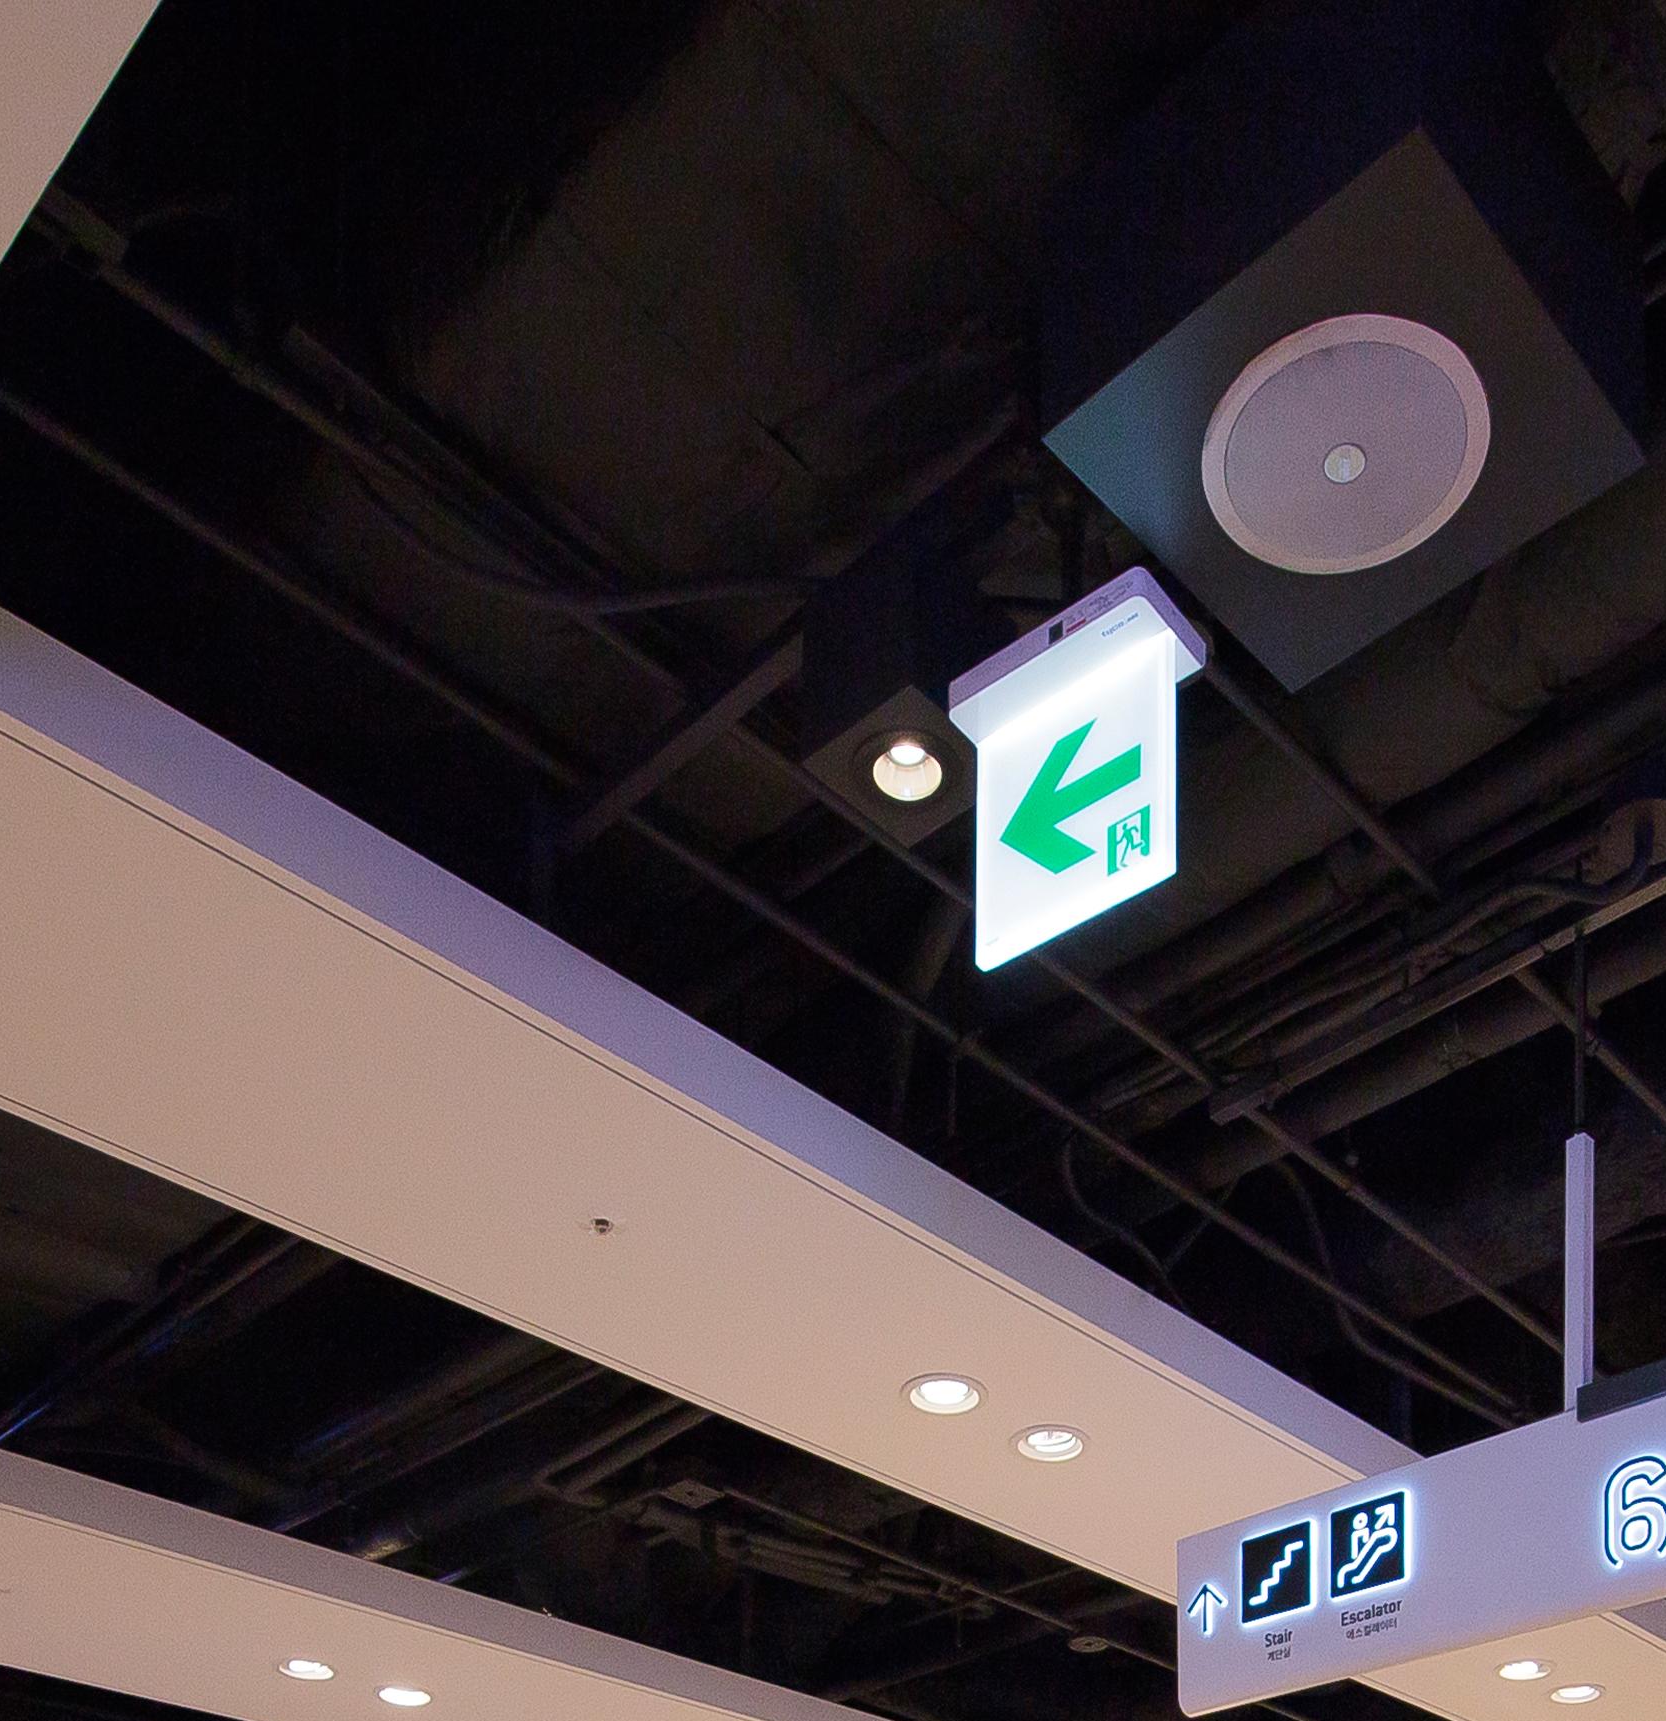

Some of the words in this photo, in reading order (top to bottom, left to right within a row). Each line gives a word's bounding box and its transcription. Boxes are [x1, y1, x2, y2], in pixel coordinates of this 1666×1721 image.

[1341, 1600, 1402, 1626] Escalator
[1264, 1628, 1293, 1648] Stair
[1346, 1617, 1398, 1640] 에스컬레이터
[1267, 1647, 1292, 1662] 계단실
